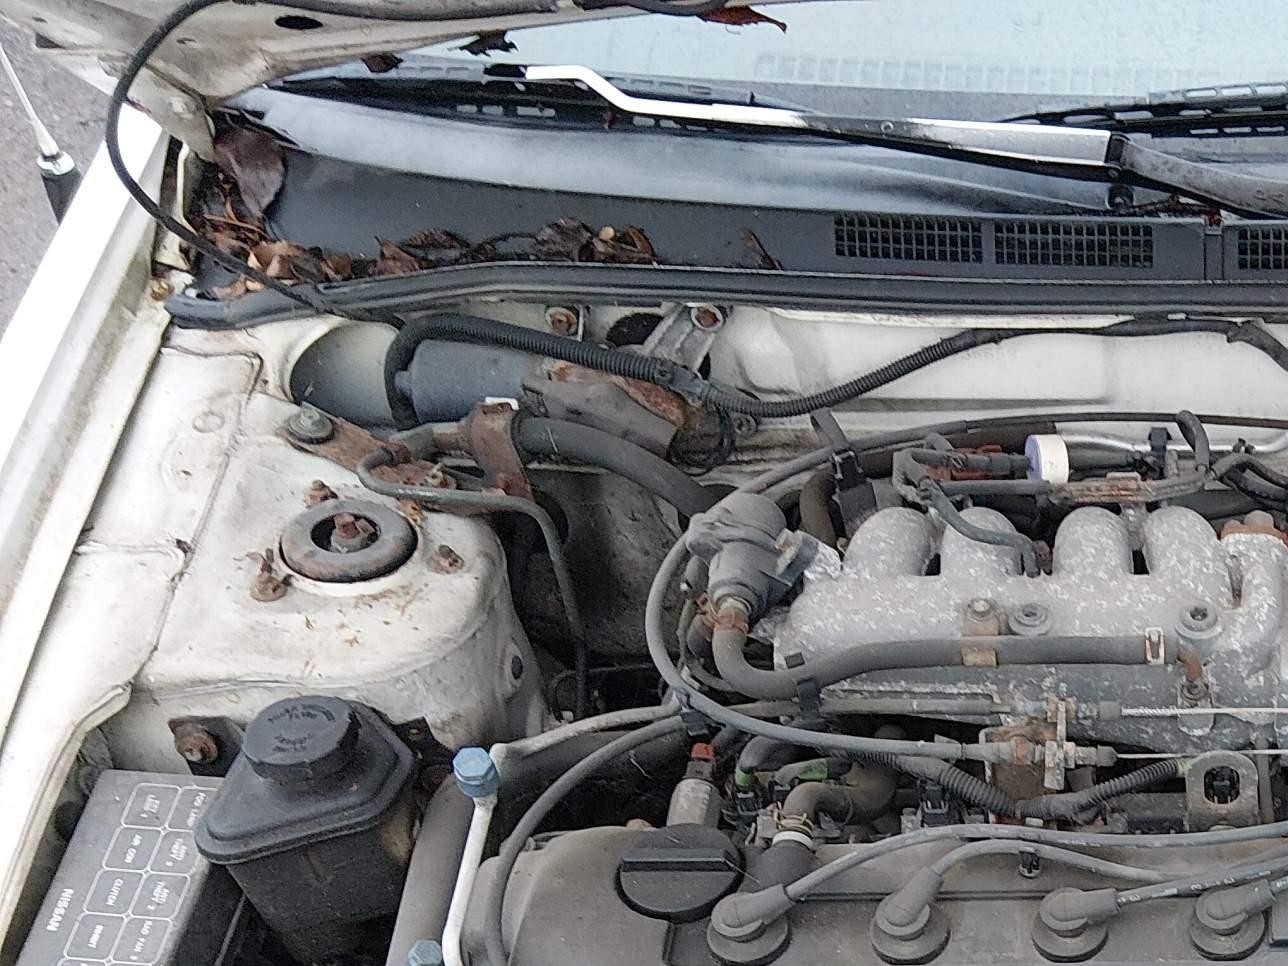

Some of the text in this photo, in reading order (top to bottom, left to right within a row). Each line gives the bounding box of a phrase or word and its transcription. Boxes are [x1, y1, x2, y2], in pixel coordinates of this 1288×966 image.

[106, 878, 124, 907] CLUTCH
[46, 888, 74, 932] NISSAN
[134, 938, 146, 953] FAN
